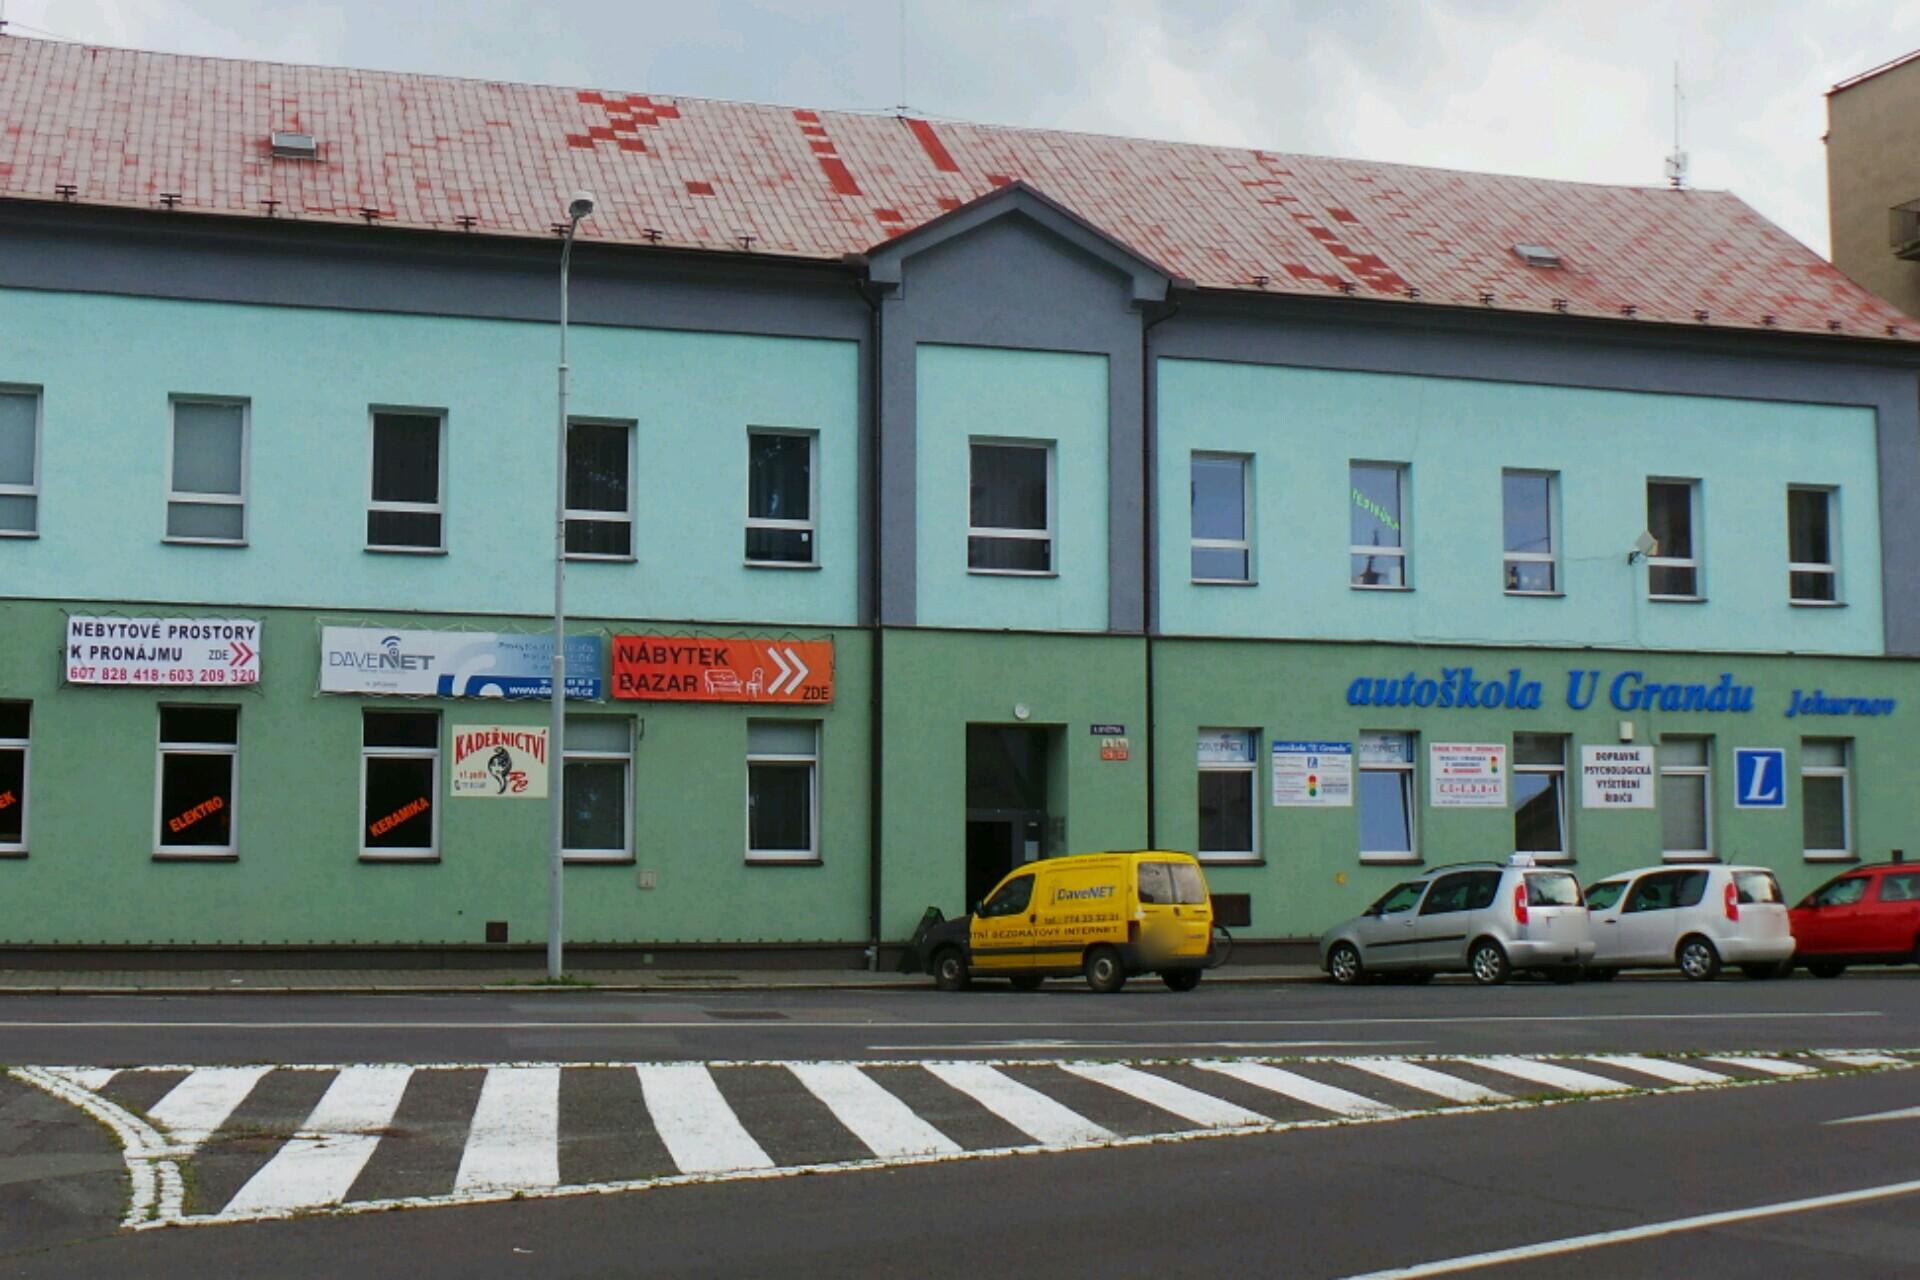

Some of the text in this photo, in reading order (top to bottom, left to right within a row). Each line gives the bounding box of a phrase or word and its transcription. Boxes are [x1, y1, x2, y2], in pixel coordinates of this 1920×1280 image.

[71, 621, 256, 640] NEBYTOVÉ PROSTORY
[70, 643, 230, 662] K PRONÁJMU ZDE
[619, 643, 729, 666] NÁBYTEK
[70, 667, 96, 679] 607
[102, 668, 127, 680] 828
[199, 670, 225, 682] 209
[231, 670, 256, 682] 320
[619, 672, 698, 692] BAZAR
[802, 686, 829, 700] ZDE
[1347, 667, 1543, 710] autoškola
[1566, 670, 1754, 712] U Grandu
[1584, 765, 1652, 775] PSYCHOLOGICKÁ
[1744, 756, 1777, 800] L
[168, 795, 224, 832] ELEKTRO
[369, 797, 430, 837] KERAMIKA
[1056, 885, 1115, 901] DaveNET
